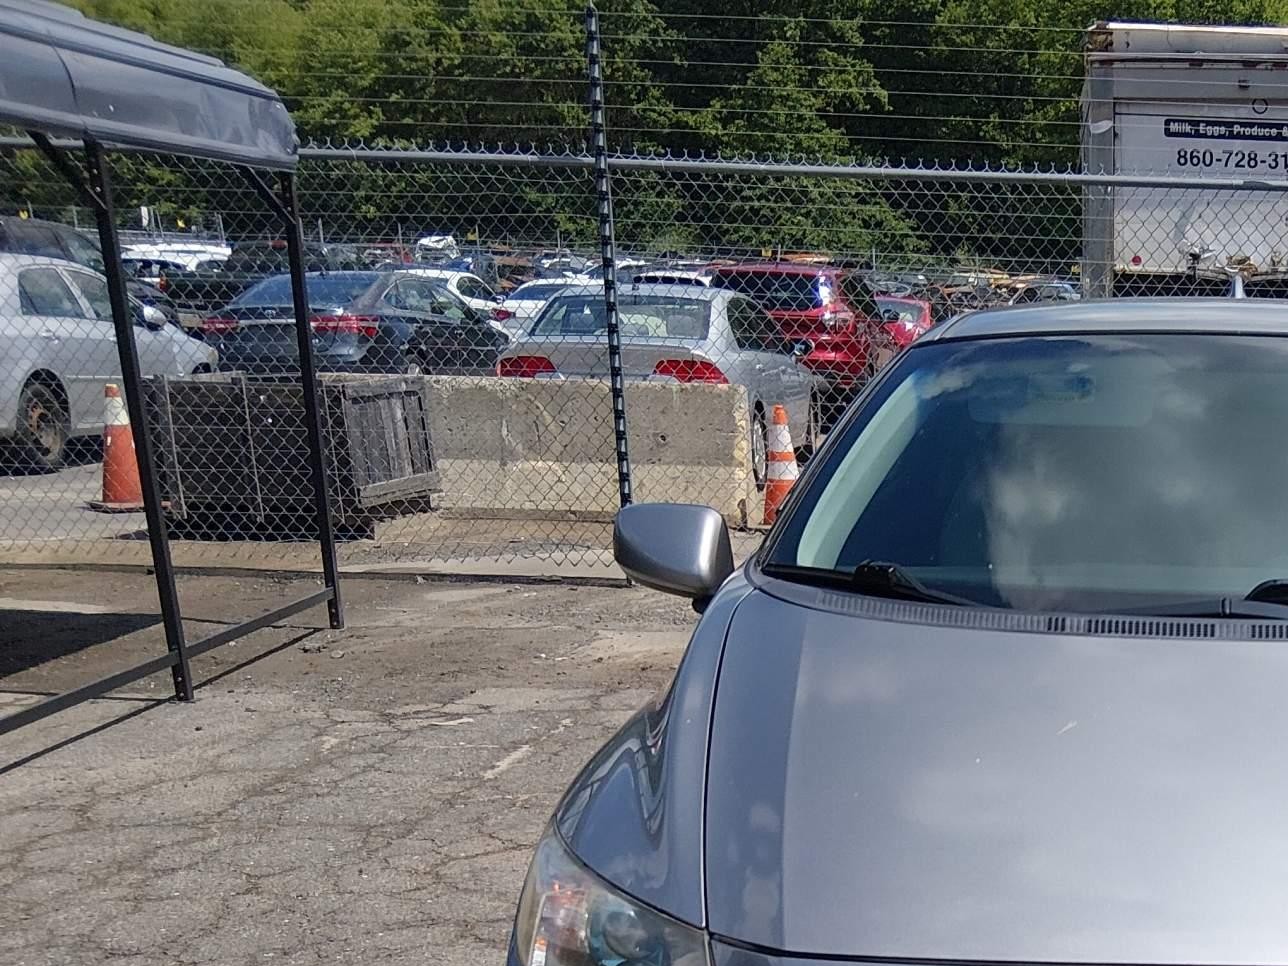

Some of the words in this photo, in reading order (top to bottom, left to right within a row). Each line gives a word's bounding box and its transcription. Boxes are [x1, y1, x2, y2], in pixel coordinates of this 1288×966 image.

[1169, 122, 1195, 135] Milk,
[1199, 122, 1229, 136] Eggs,
[1233, 125, 1277, 137] Produce
